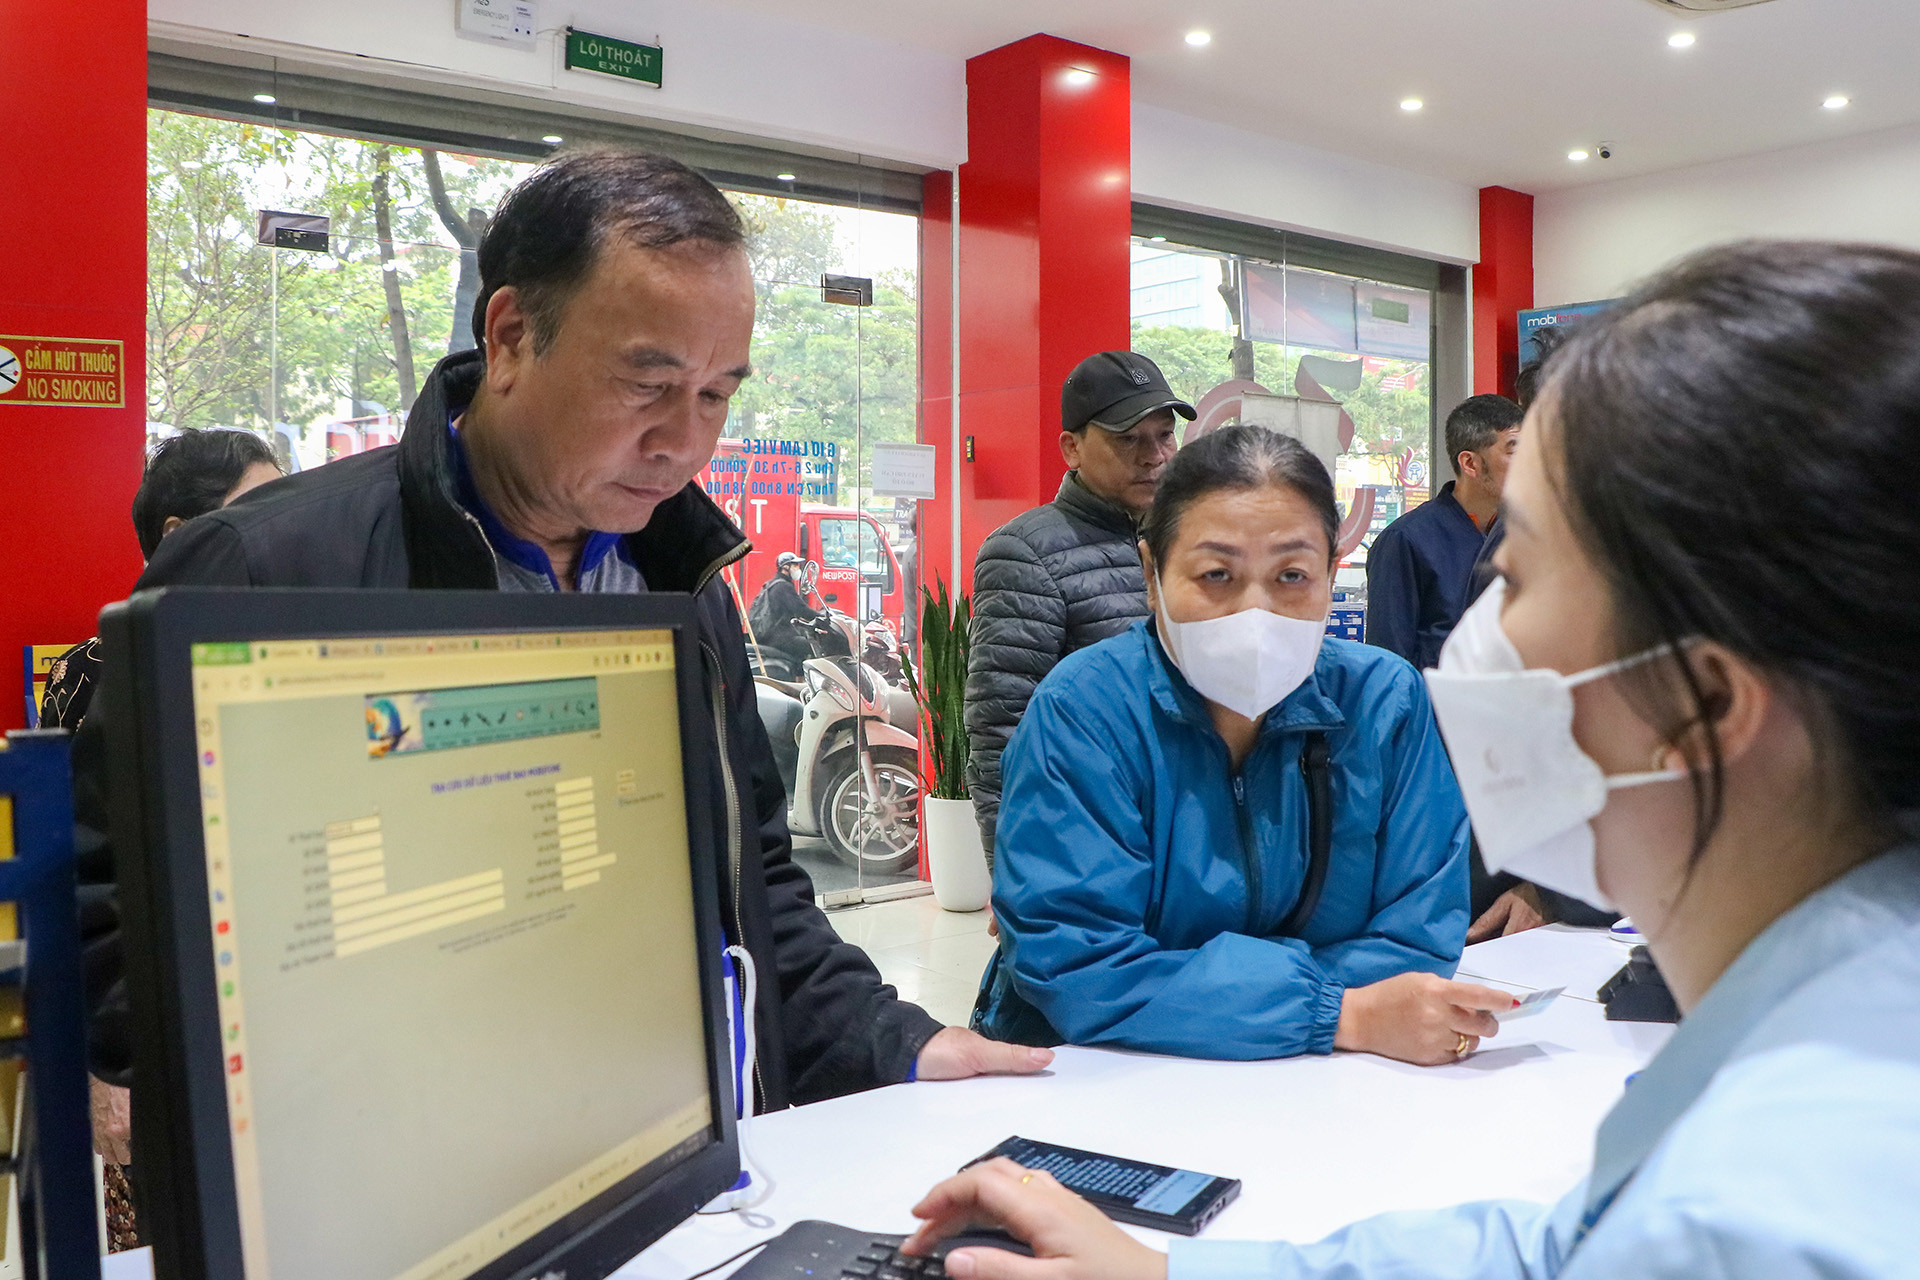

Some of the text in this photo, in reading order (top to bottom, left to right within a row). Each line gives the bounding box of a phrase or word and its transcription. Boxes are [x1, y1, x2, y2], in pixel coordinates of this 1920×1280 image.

[598, 60, 632, 73] EXIT
[605, 46, 652, 67] THOÁT
[54, 347, 77, 372] HÚT
[79, 346, 116, 373] THUỐC
[27, 378, 117, 402] NO SMOKING
